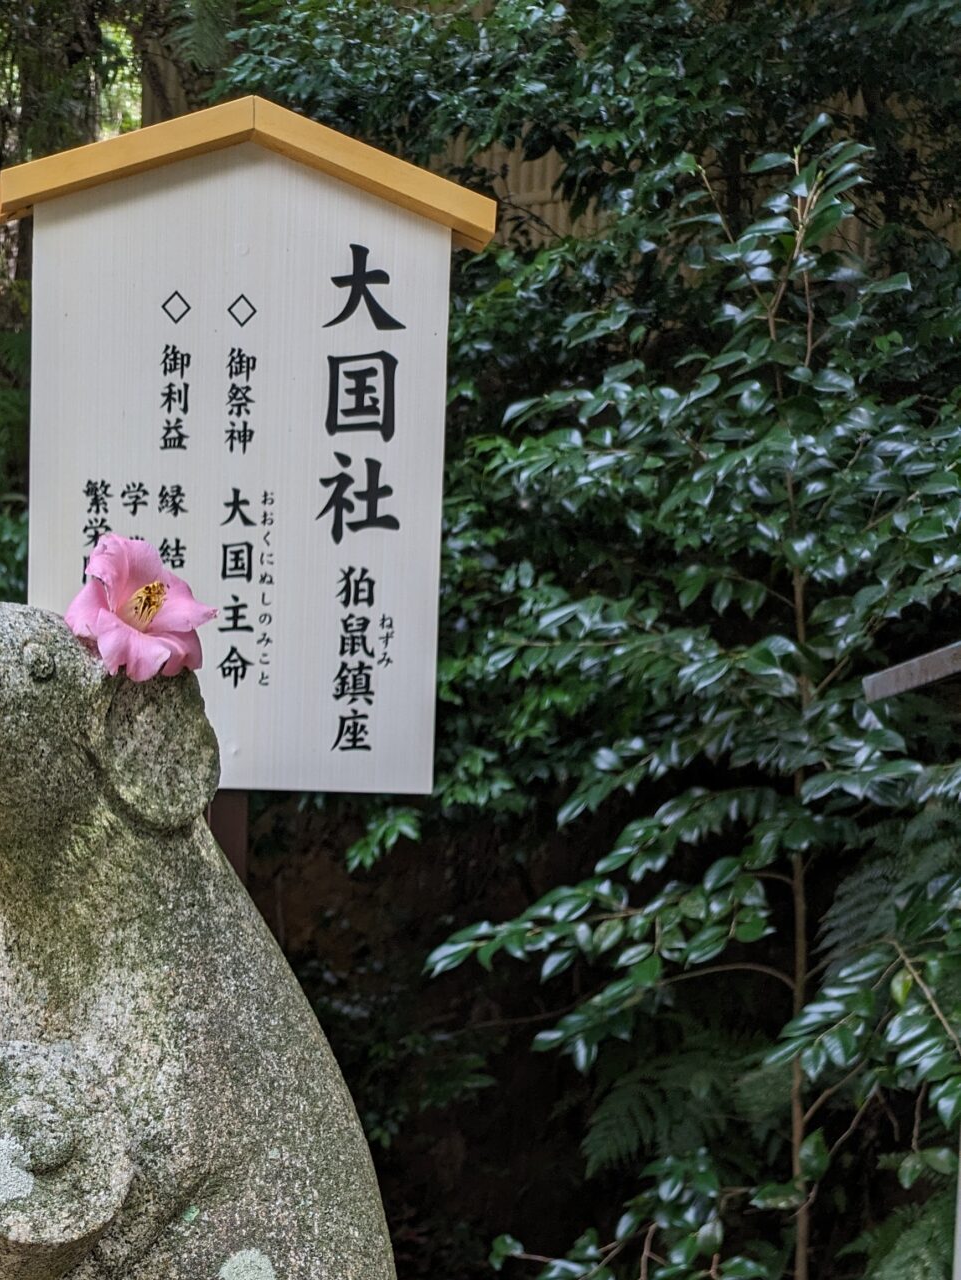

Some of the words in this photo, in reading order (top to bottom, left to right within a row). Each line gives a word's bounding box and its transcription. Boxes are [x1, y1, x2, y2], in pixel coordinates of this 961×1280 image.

[159, 344, 191, 451] 御利益
[224, 347, 256, 455] 御祭神
[315, 244, 406, 545] 大国社
[82, 479, 114, 584] 繁栄
[216, 487, 257, 689] 大国主命
[256, 489, 275, 687] おおくにぬしのみこと
[330, 566, 376, 751] 狛鼠鎮座
[377, 613, 394, 668] ねずみ
